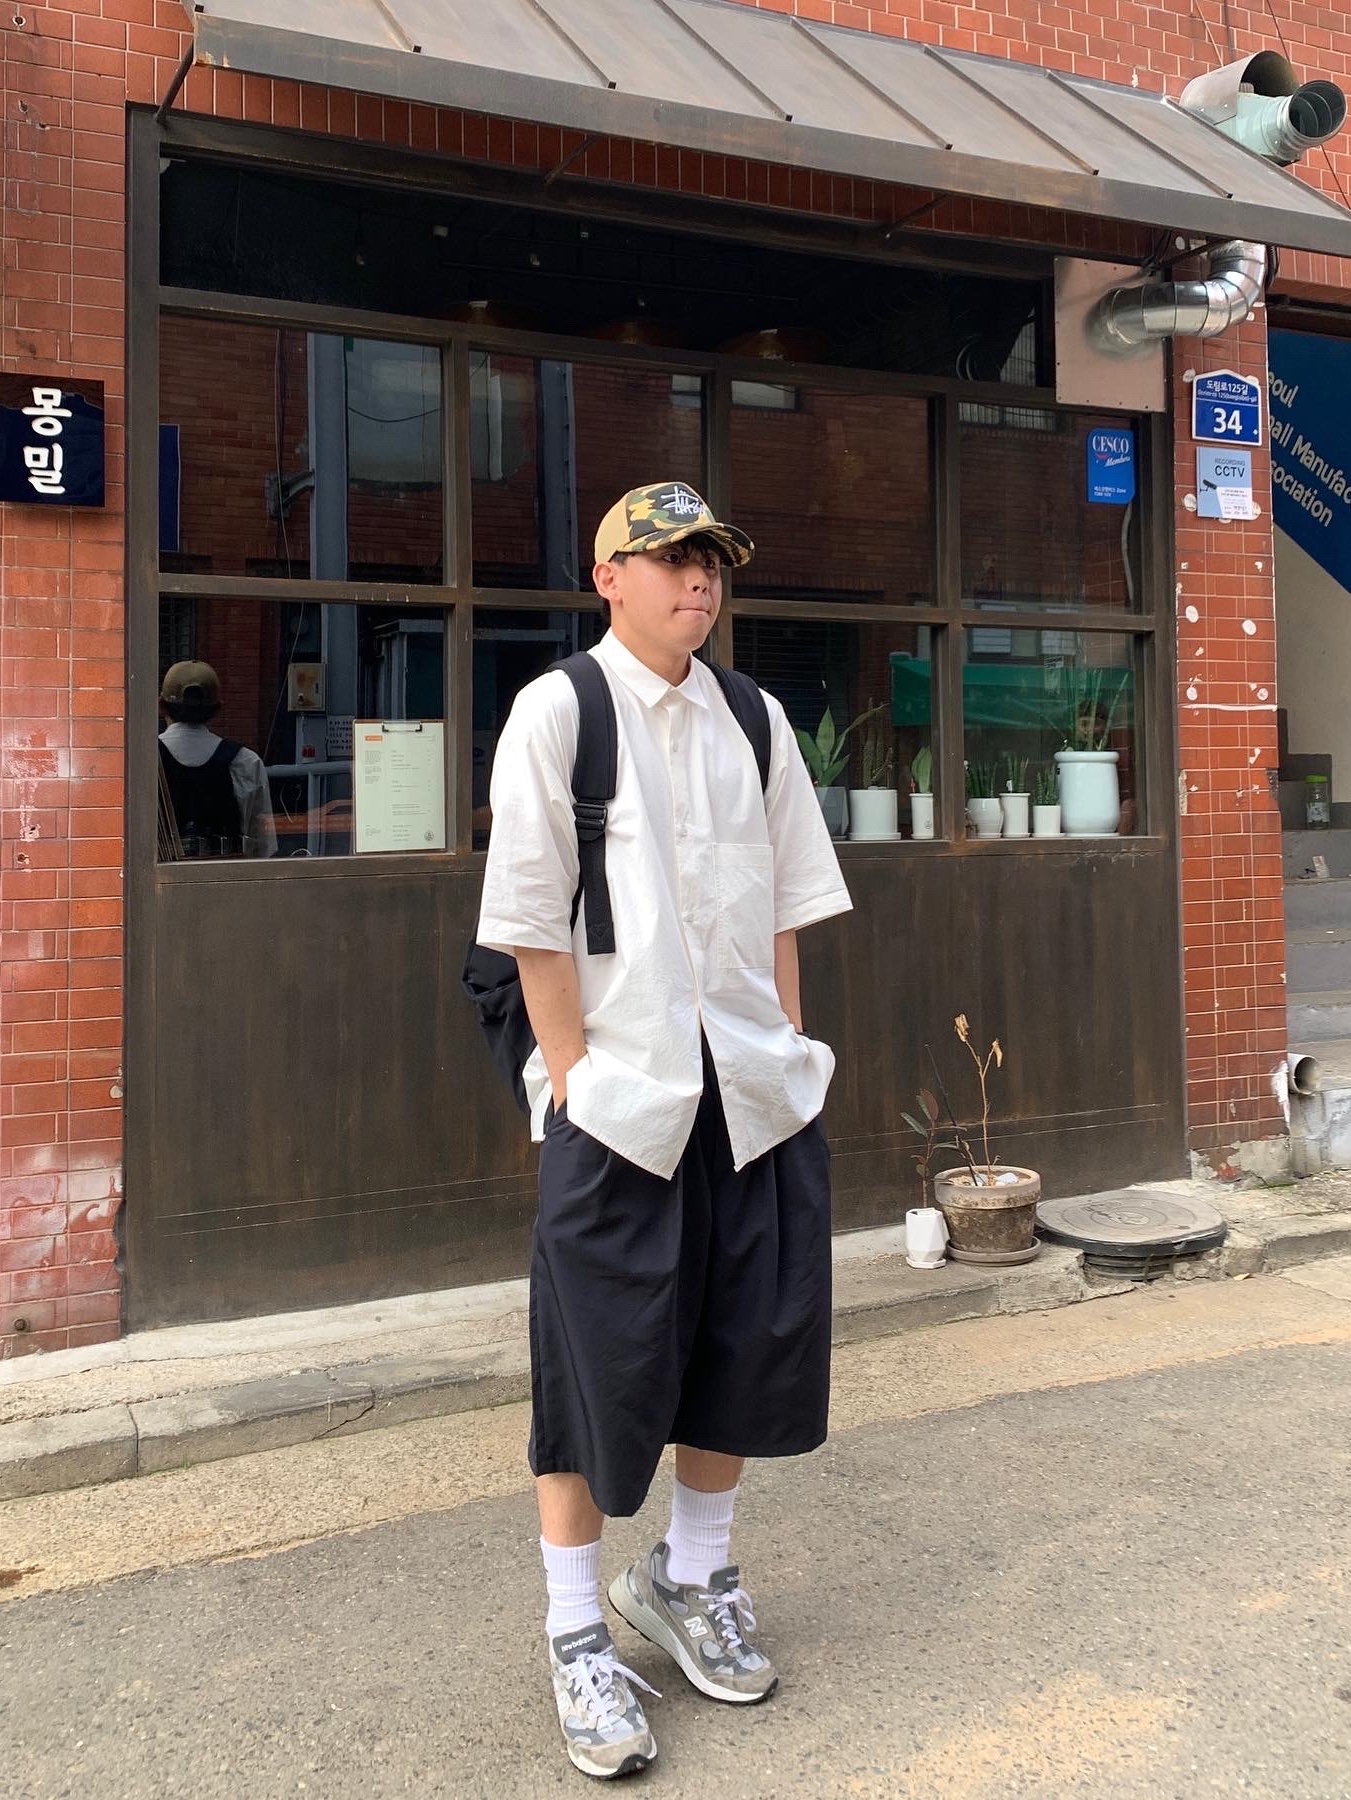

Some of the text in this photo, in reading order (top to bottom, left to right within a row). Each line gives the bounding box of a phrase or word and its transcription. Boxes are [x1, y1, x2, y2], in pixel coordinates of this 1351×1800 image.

[1206, 380, 1249, 396] 도림로125길
[1213, 407, 1243, 436] 34
[21, 386, 73, 494] 몽밀
[1092, 435, 1130, 454] CESCO
[1214, 465, 1245, 478] CCTV
[684, 1615, 707, 1639] N
